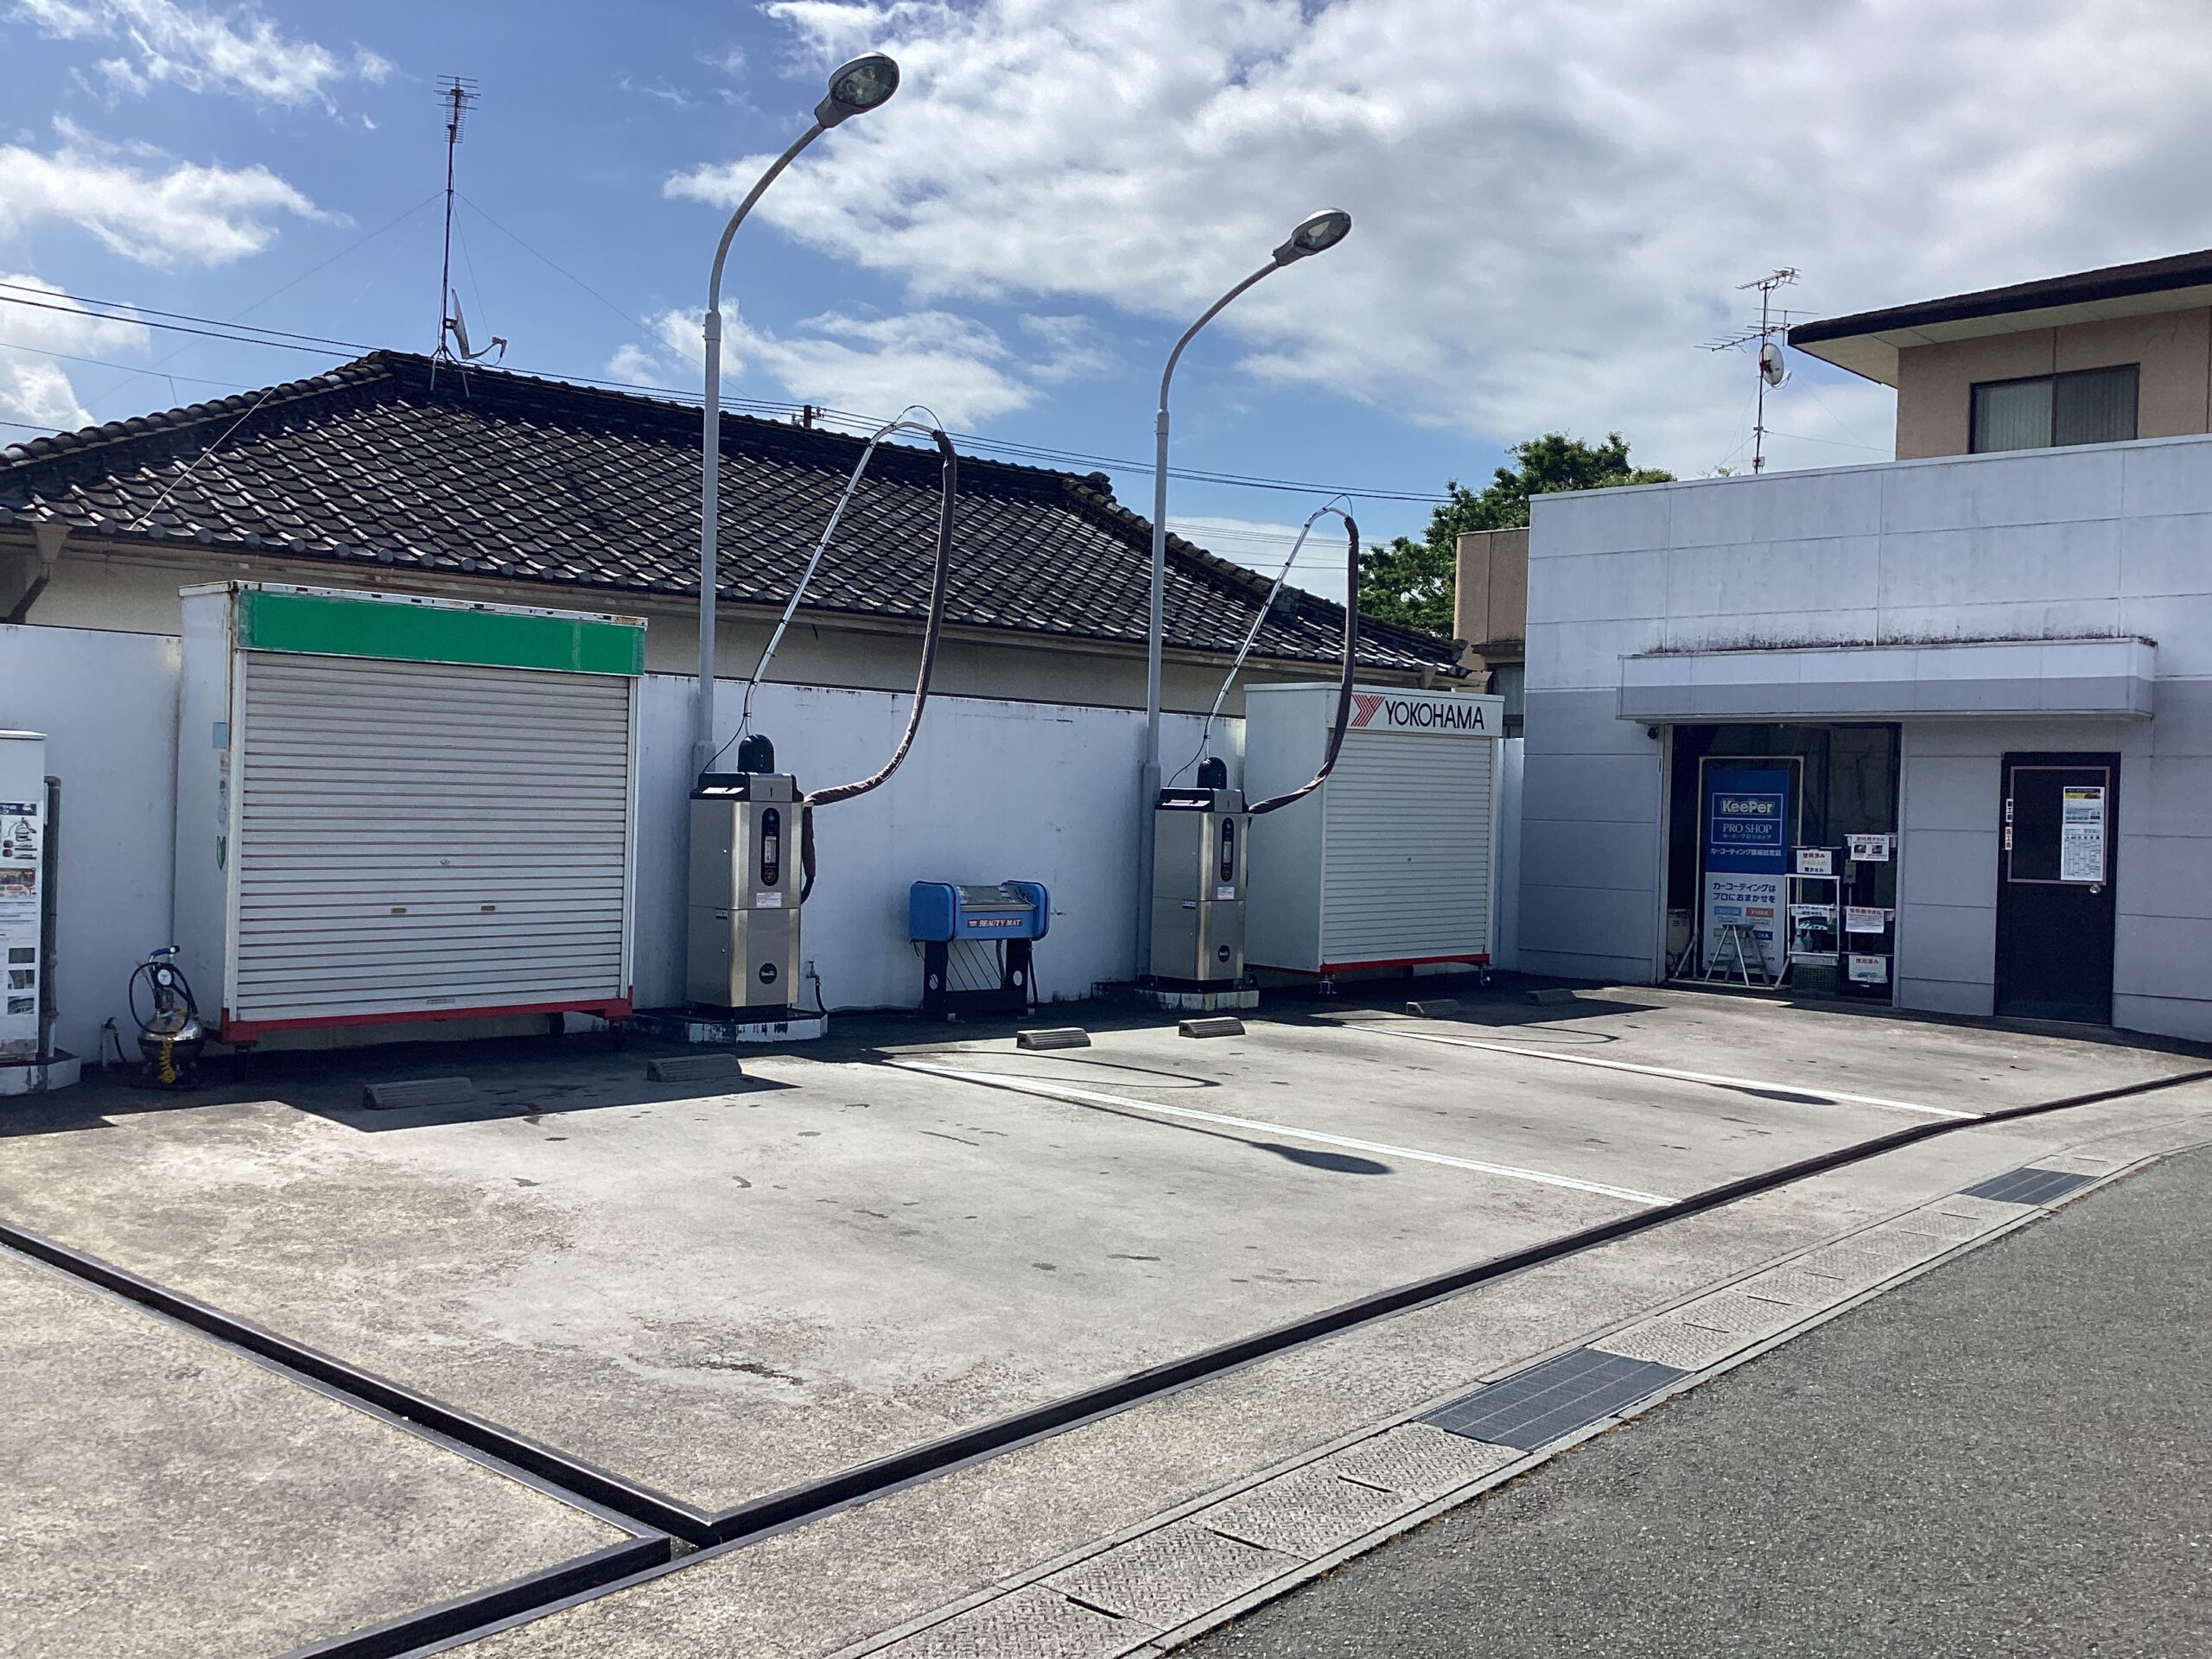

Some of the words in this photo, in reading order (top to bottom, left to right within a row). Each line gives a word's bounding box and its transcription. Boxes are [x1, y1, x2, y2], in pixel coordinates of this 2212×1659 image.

[1385, 700, 1485, 730] YOKOHAMA
[1722, 799, 1774, 814] KeePer
[1723, 823, 1744, 833] PRO
[1745, 823, 1772, 834] SHOP
[1713, 882, 1776, 893] カーコーティングは
[1713, 893, 1777, 903] プロにおまかせを
